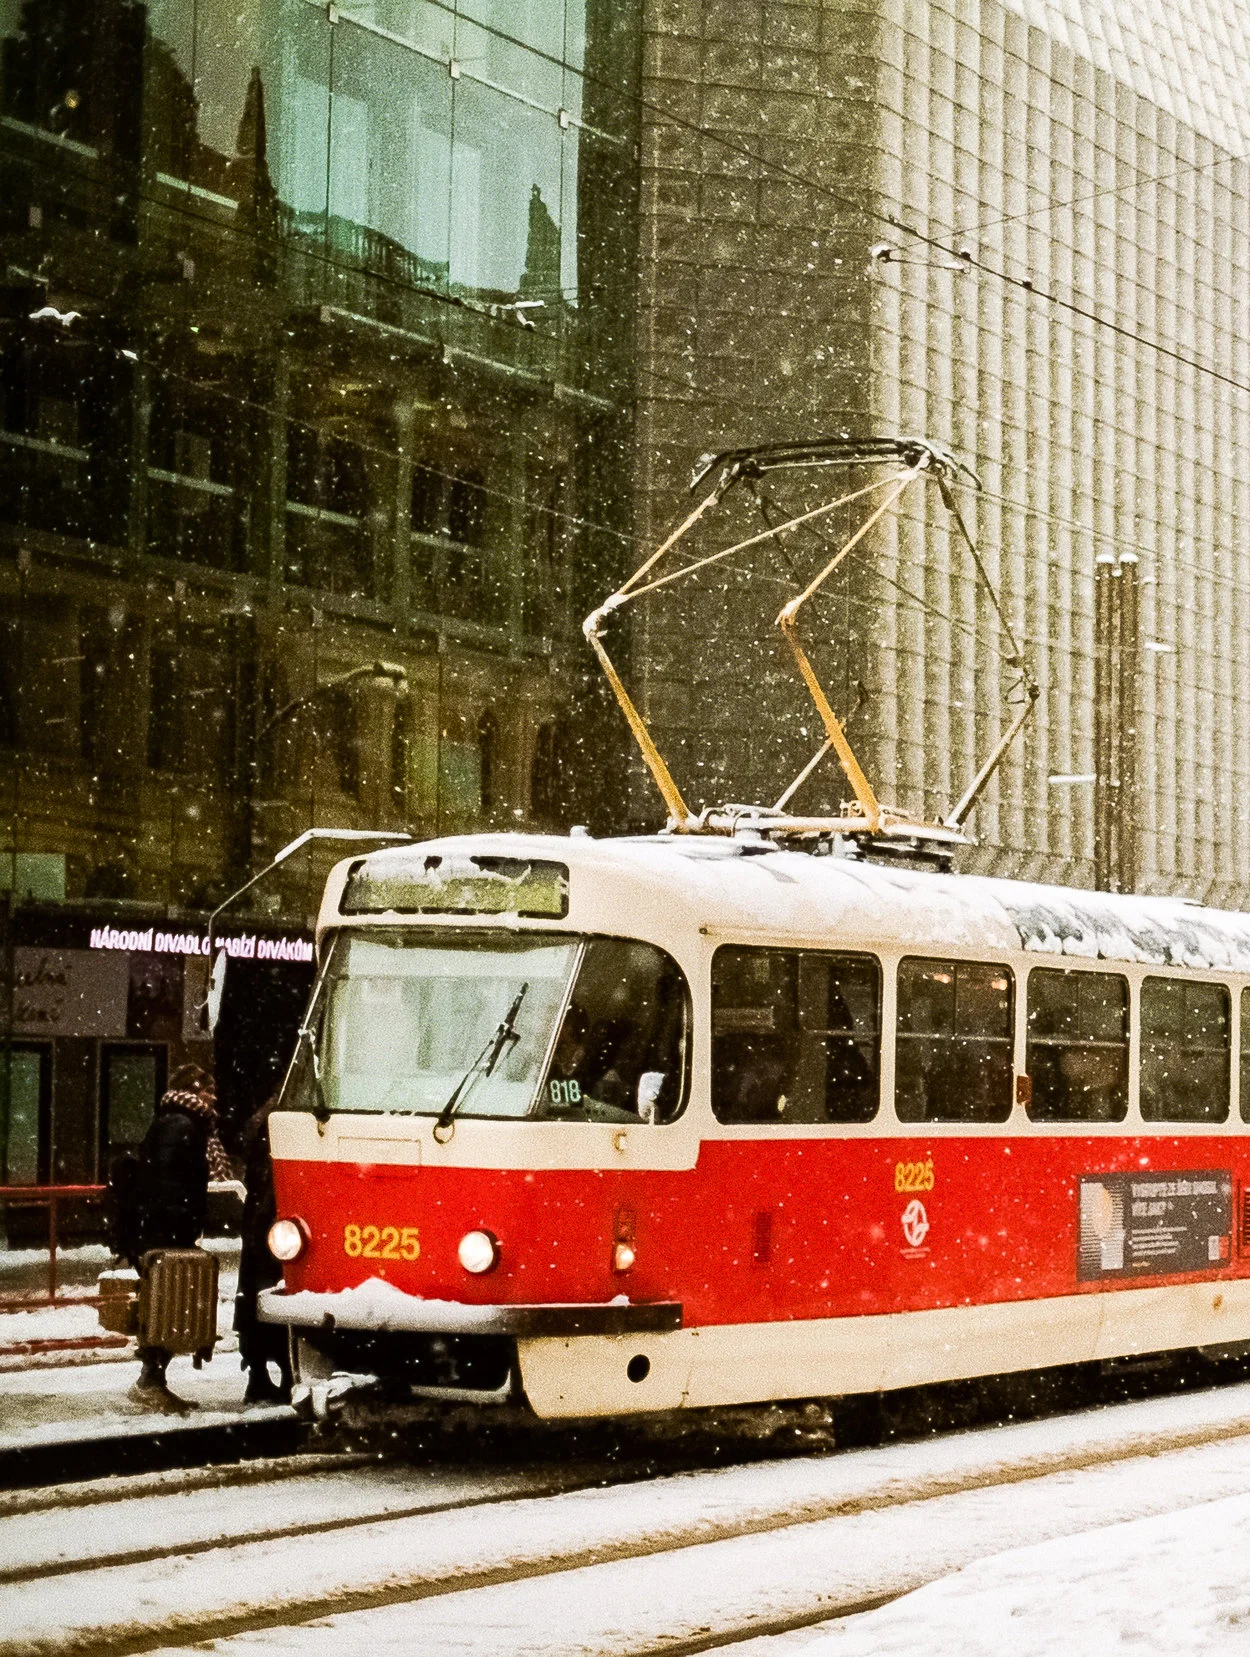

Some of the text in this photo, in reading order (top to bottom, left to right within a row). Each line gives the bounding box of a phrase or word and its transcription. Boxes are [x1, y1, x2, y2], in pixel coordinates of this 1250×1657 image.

[90, 925, 153, 951] NÁRODNÍ
[155, 932, 211, 956] DIVADLO
[550, 1079, 581, 1105] 818
[895, 1159, 935, 1193] 8225
[343, 1224, 421, 1261] 8225
